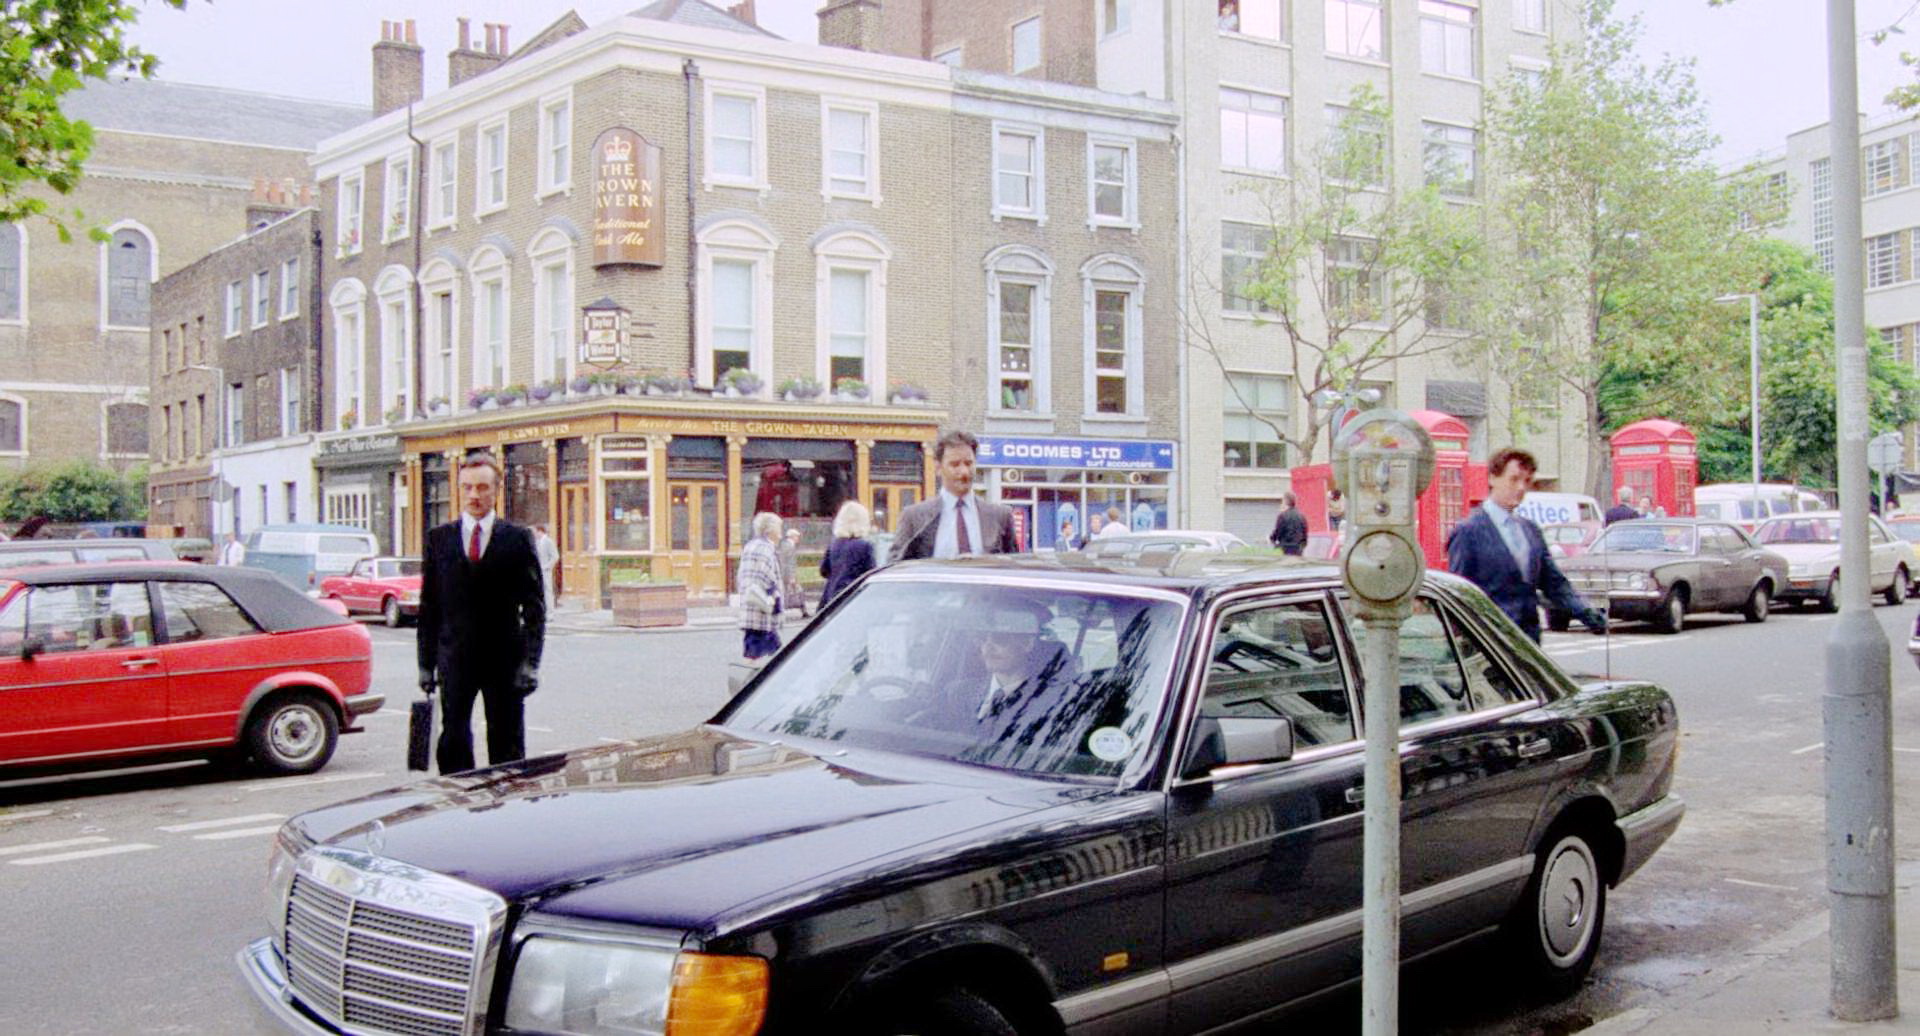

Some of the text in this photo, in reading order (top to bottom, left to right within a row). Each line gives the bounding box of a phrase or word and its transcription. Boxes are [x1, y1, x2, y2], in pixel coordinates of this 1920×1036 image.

[602, 163, 635, 176] THE
[598, 178, 652, 192] ROWN
[711, 420, 737, 432] THE
[802, 424, 849, 436] TAVERN
[1086, 459, 1104, 468] turf
